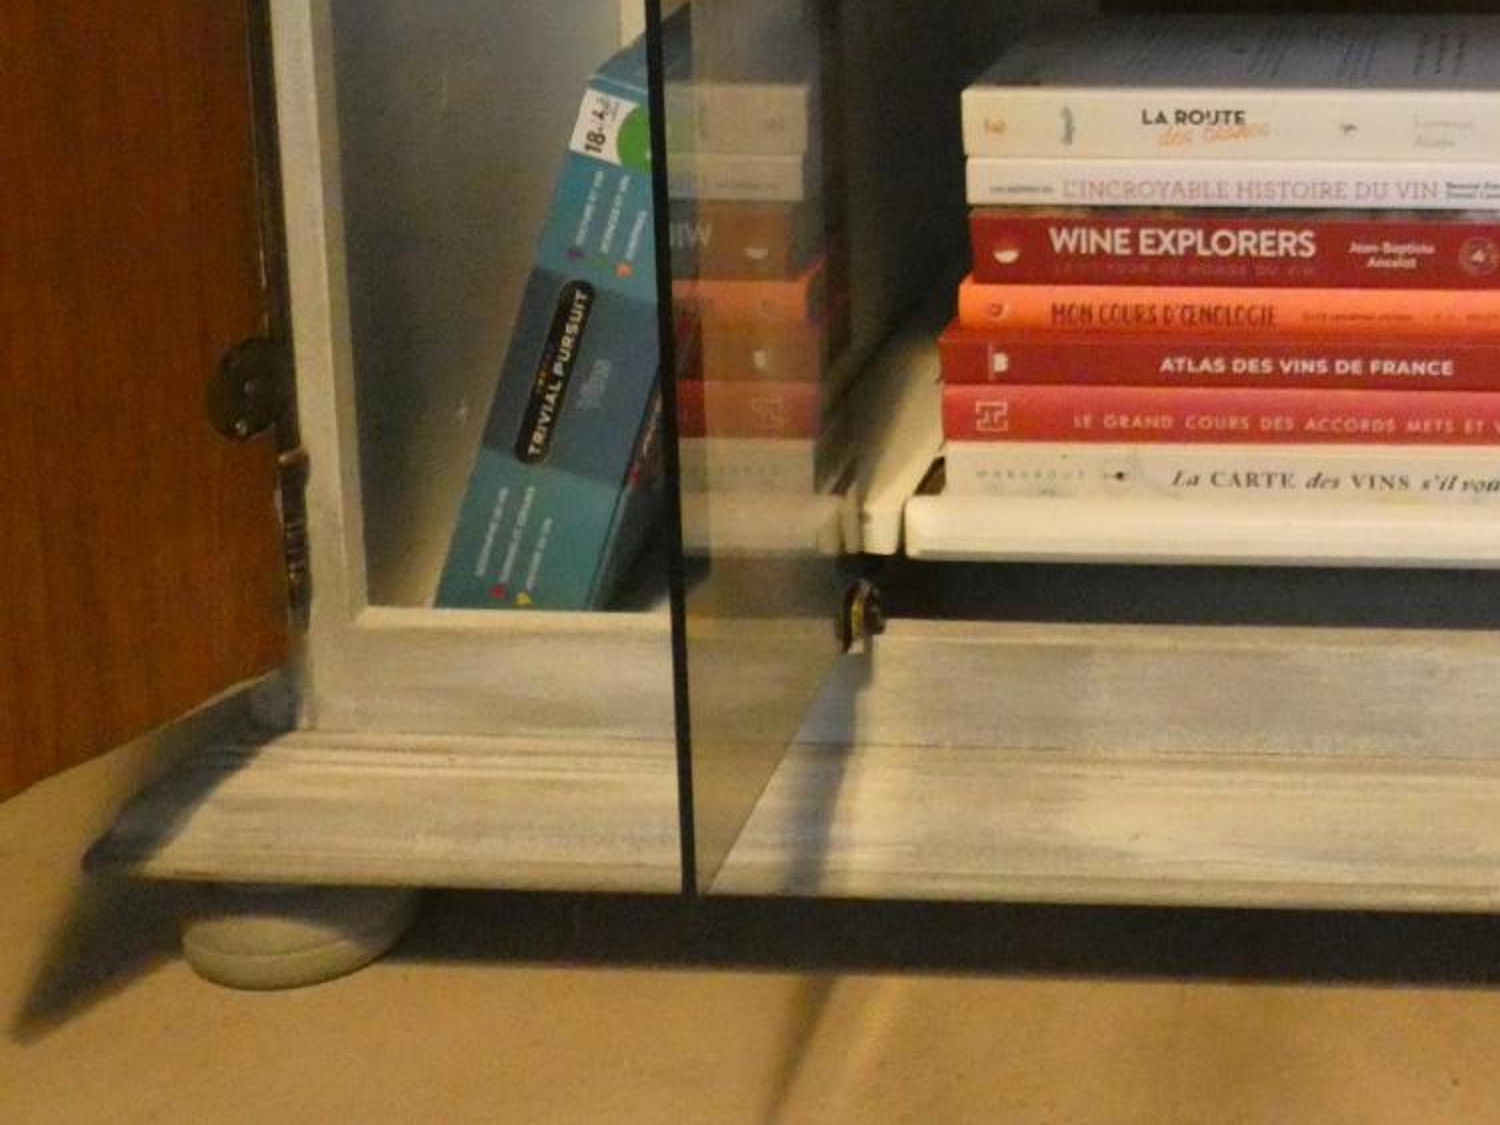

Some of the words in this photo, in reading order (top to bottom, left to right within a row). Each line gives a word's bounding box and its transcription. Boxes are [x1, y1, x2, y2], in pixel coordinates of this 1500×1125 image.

[1141, 109, 1168, 125] LA
[1174, 109, 1247, 127] ROUTE
[1063, 179, 1230, 200] L'INCROYABLE
[1236, 180, 1348, 200] HISTOIRE
[1354, 181, 1387, 200] DU
[1400, 181, 1439, 201] VIN
[1050, 227, 1131, 255] WINE
[1139, 229, 1317, 258] EXPLORERS
[1051, 303, 1095, 325] MON
[1099, 303, 1157, 325] COURS
[527, 379, 562, 458] TRIVIAL
[553, 288, 589, 376] PURSUIT
[1160, 357, 1226, 374] ATLAS
[1232, 357, 1273, 374] DES
[1279, 358, 1329, 375] VINS
[1334, 359, 1364, 375] DE
[1369, 359, 1455, 376] FRANCE
[1073, 414, 1094, 428] LE
[1103, 415, 1175, 429] GRAND
[1184, 416, 1251, 430] COURS
[1259, 417, 1296, 431] DES
[1303, 418, 1397, 433] ACCORDS
[1406, 420, 1455, 434] METS
[1463, 420, 1485, 434] ET
[1171, 470, 1201, 489] La
[1209, 470, 1297, 489] CARTE
[1304, 472, 1340, 490] des
[1350, 474, 1410, 491] VINS
[1420, 474, 1458, 492] s'il
